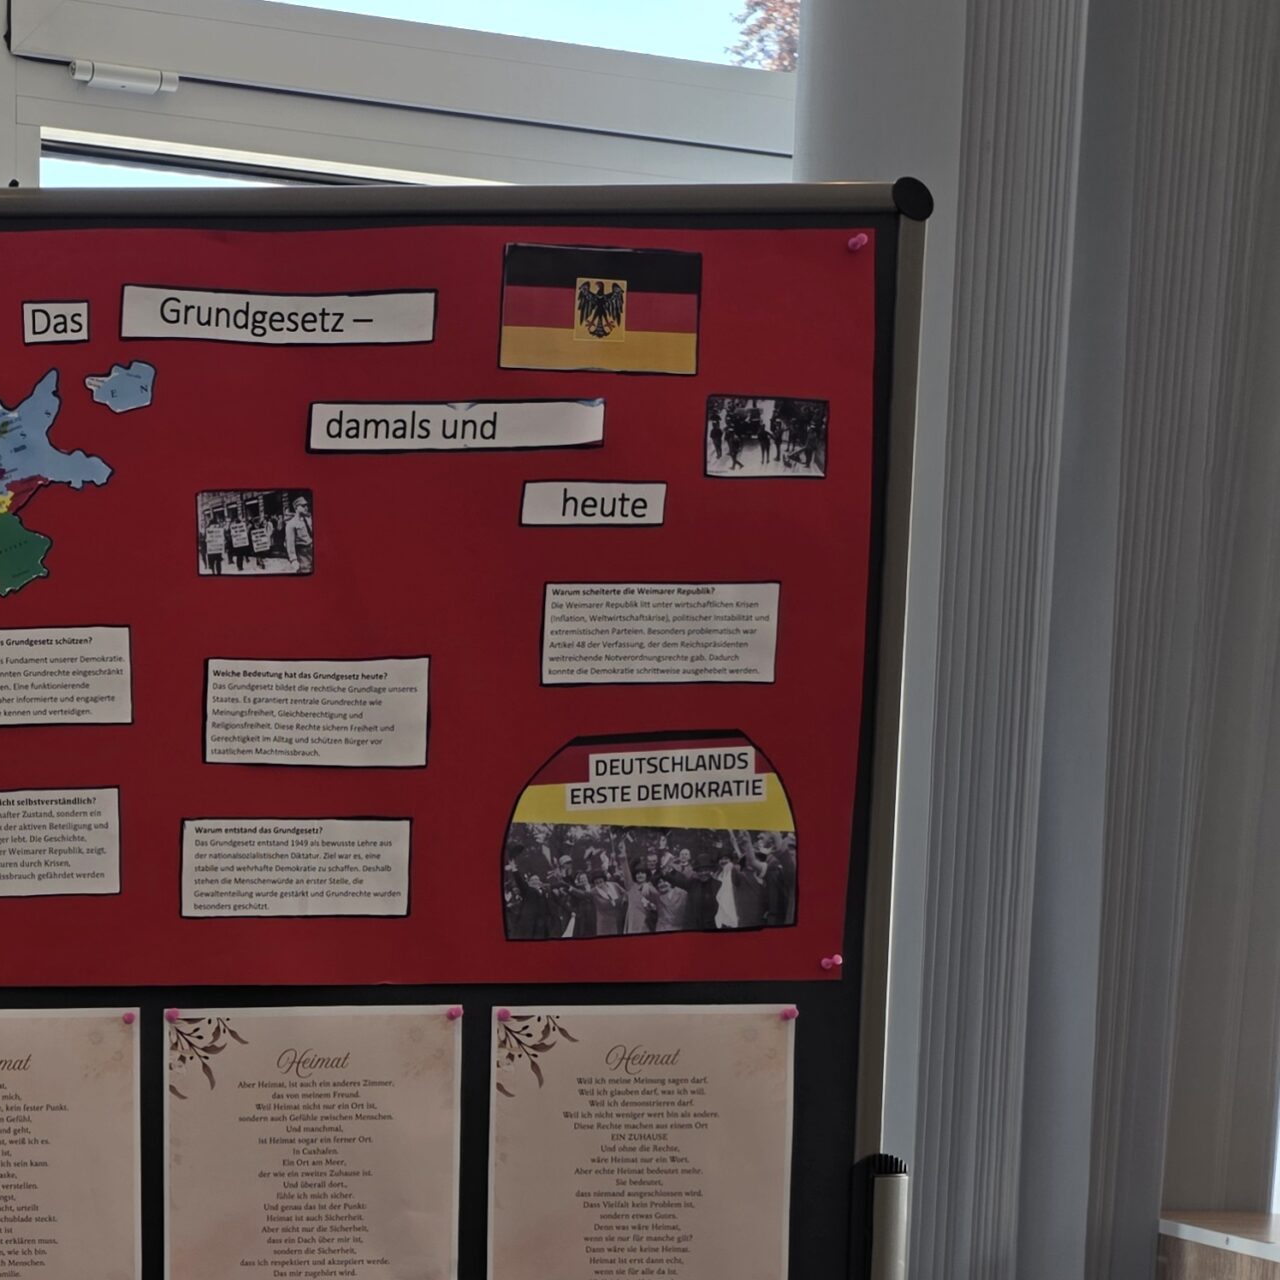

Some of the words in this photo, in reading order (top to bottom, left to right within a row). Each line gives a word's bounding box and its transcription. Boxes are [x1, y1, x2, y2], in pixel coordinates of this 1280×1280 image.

[31, 309, 84, 335] Das
[159, 298, 344, 337] Grundgesetz
[326, 411, 432, 440] damals
[440, 413, 498, 440] und
[562, 489, 648, 520] heute
[552, 588, 580, 596] Warum
[583, 587, 621, 595] scheiterte
[623, 587, 635, 595] die
[637, 587, 675, 595] Weimarer
[677, 586, 715, 596] Republik?
[6, 638, 53, 647] Grundgesetz
[55, 637, 92, 645] schützen?
[213, 670, 240, 678] Welche
[243, 670, 283, 679] Bedeutung
[298, 671, 311, 679] das
[313, 672, 359, 680] Grundgesetz
[361, 672, 387, 680] heute?
[595, 752, 748, 776] DEUTSCHLANDS
[17, 797, 96, 806] selbstverständlich?
[570, 786, 631, 805] ERSTE
[638, 779, 763, 802] DEMOKRATIE
[273, 827, 322, 835] Grundgesetz?
[276, 1048, 350, 1078] Heimat
[605, 1045, 681, 1075] Heimat
[628, 1133, 668, 1141] ZUHAUSE
